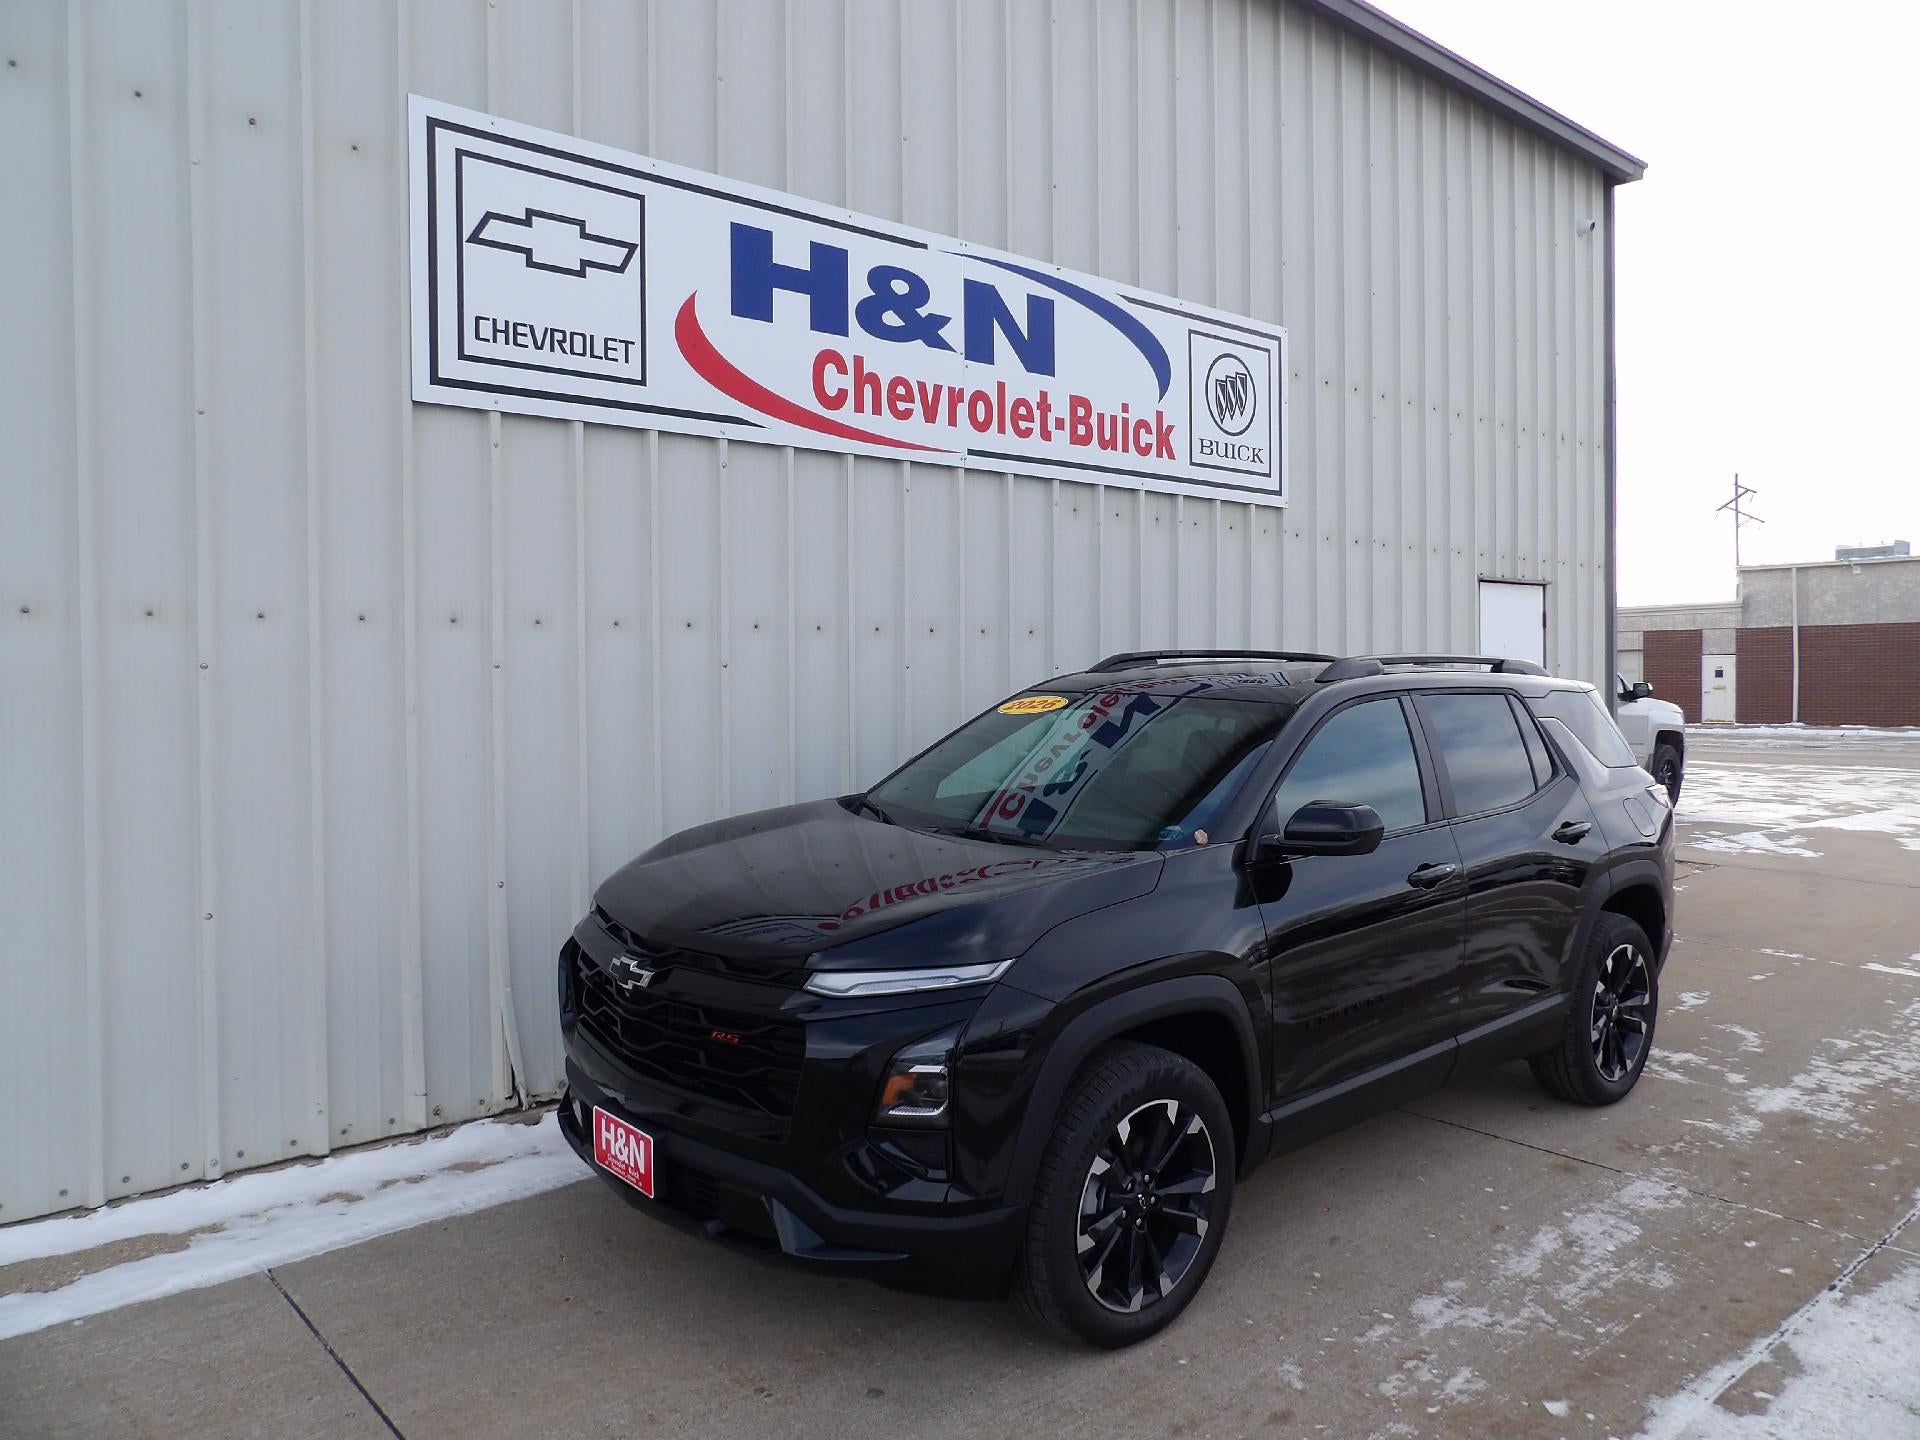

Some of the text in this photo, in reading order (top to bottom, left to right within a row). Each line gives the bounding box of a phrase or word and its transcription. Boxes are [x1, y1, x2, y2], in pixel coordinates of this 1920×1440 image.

[730, 222, 1056, 377] H&N
[474, 315, 635, 365] CHEVROLET
[811, 348, 1175, 460] Chevrolet-Buick
[1199, 438, 1264, 464] BUICK
[711, 1031, 738, 1043] RS
[602, 1117, 645, 1174] H&N
